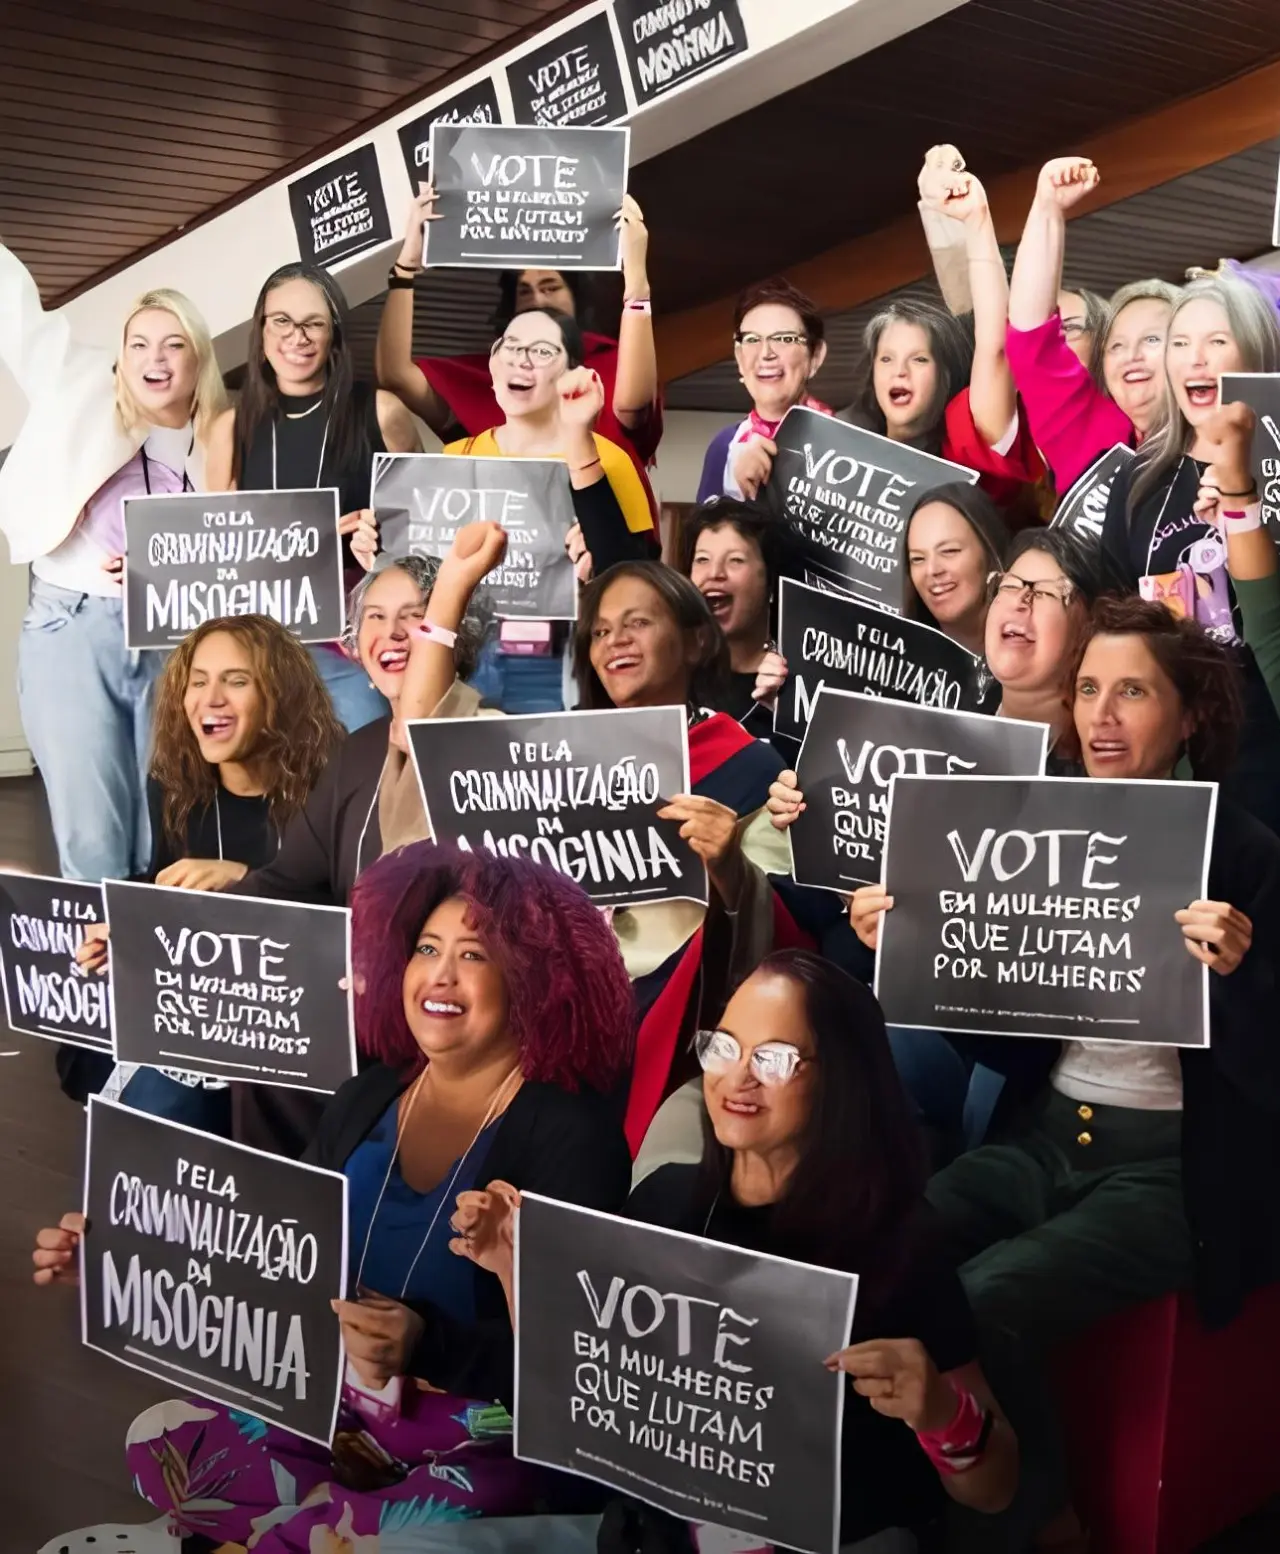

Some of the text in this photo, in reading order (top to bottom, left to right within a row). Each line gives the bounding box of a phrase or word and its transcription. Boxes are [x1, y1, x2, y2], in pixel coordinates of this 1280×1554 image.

[471, 152, 579, 188] VOTE
[413, 487, 528, 526] VOTE
[803, 442, 917, 511] VOTE
[146, 575, 319, 632] MISOGINIA
[946, 828, 1128, 890] VOTE
[938, 890, 1141, 922] EM MULHERES
[154, 925, 290, 983] VOTE
[941, 917, 1132, 959] QUE LUTAM
[15, 965, 112, 1030] MISOGI
[933, 953, 1146, 993] POR MULHERES
[216, 1002, 301, 1033] LUTAM
[177, 1157, 240, 1202] PELA
[109, 1171, 318, 1284] CRIMINALIZAÇÃO
[102, 1250, 311, 1400] MISOGINIA
[576, 1269, 760, 1374] VOTE
[574, 1330, 774, 1411] EM MULHERES
[574, 1362, 763, 1451] QUE LUTAM
[570, 1396, 621, 1435] POR
[629, 1420, 775, 1487] MULHERES
